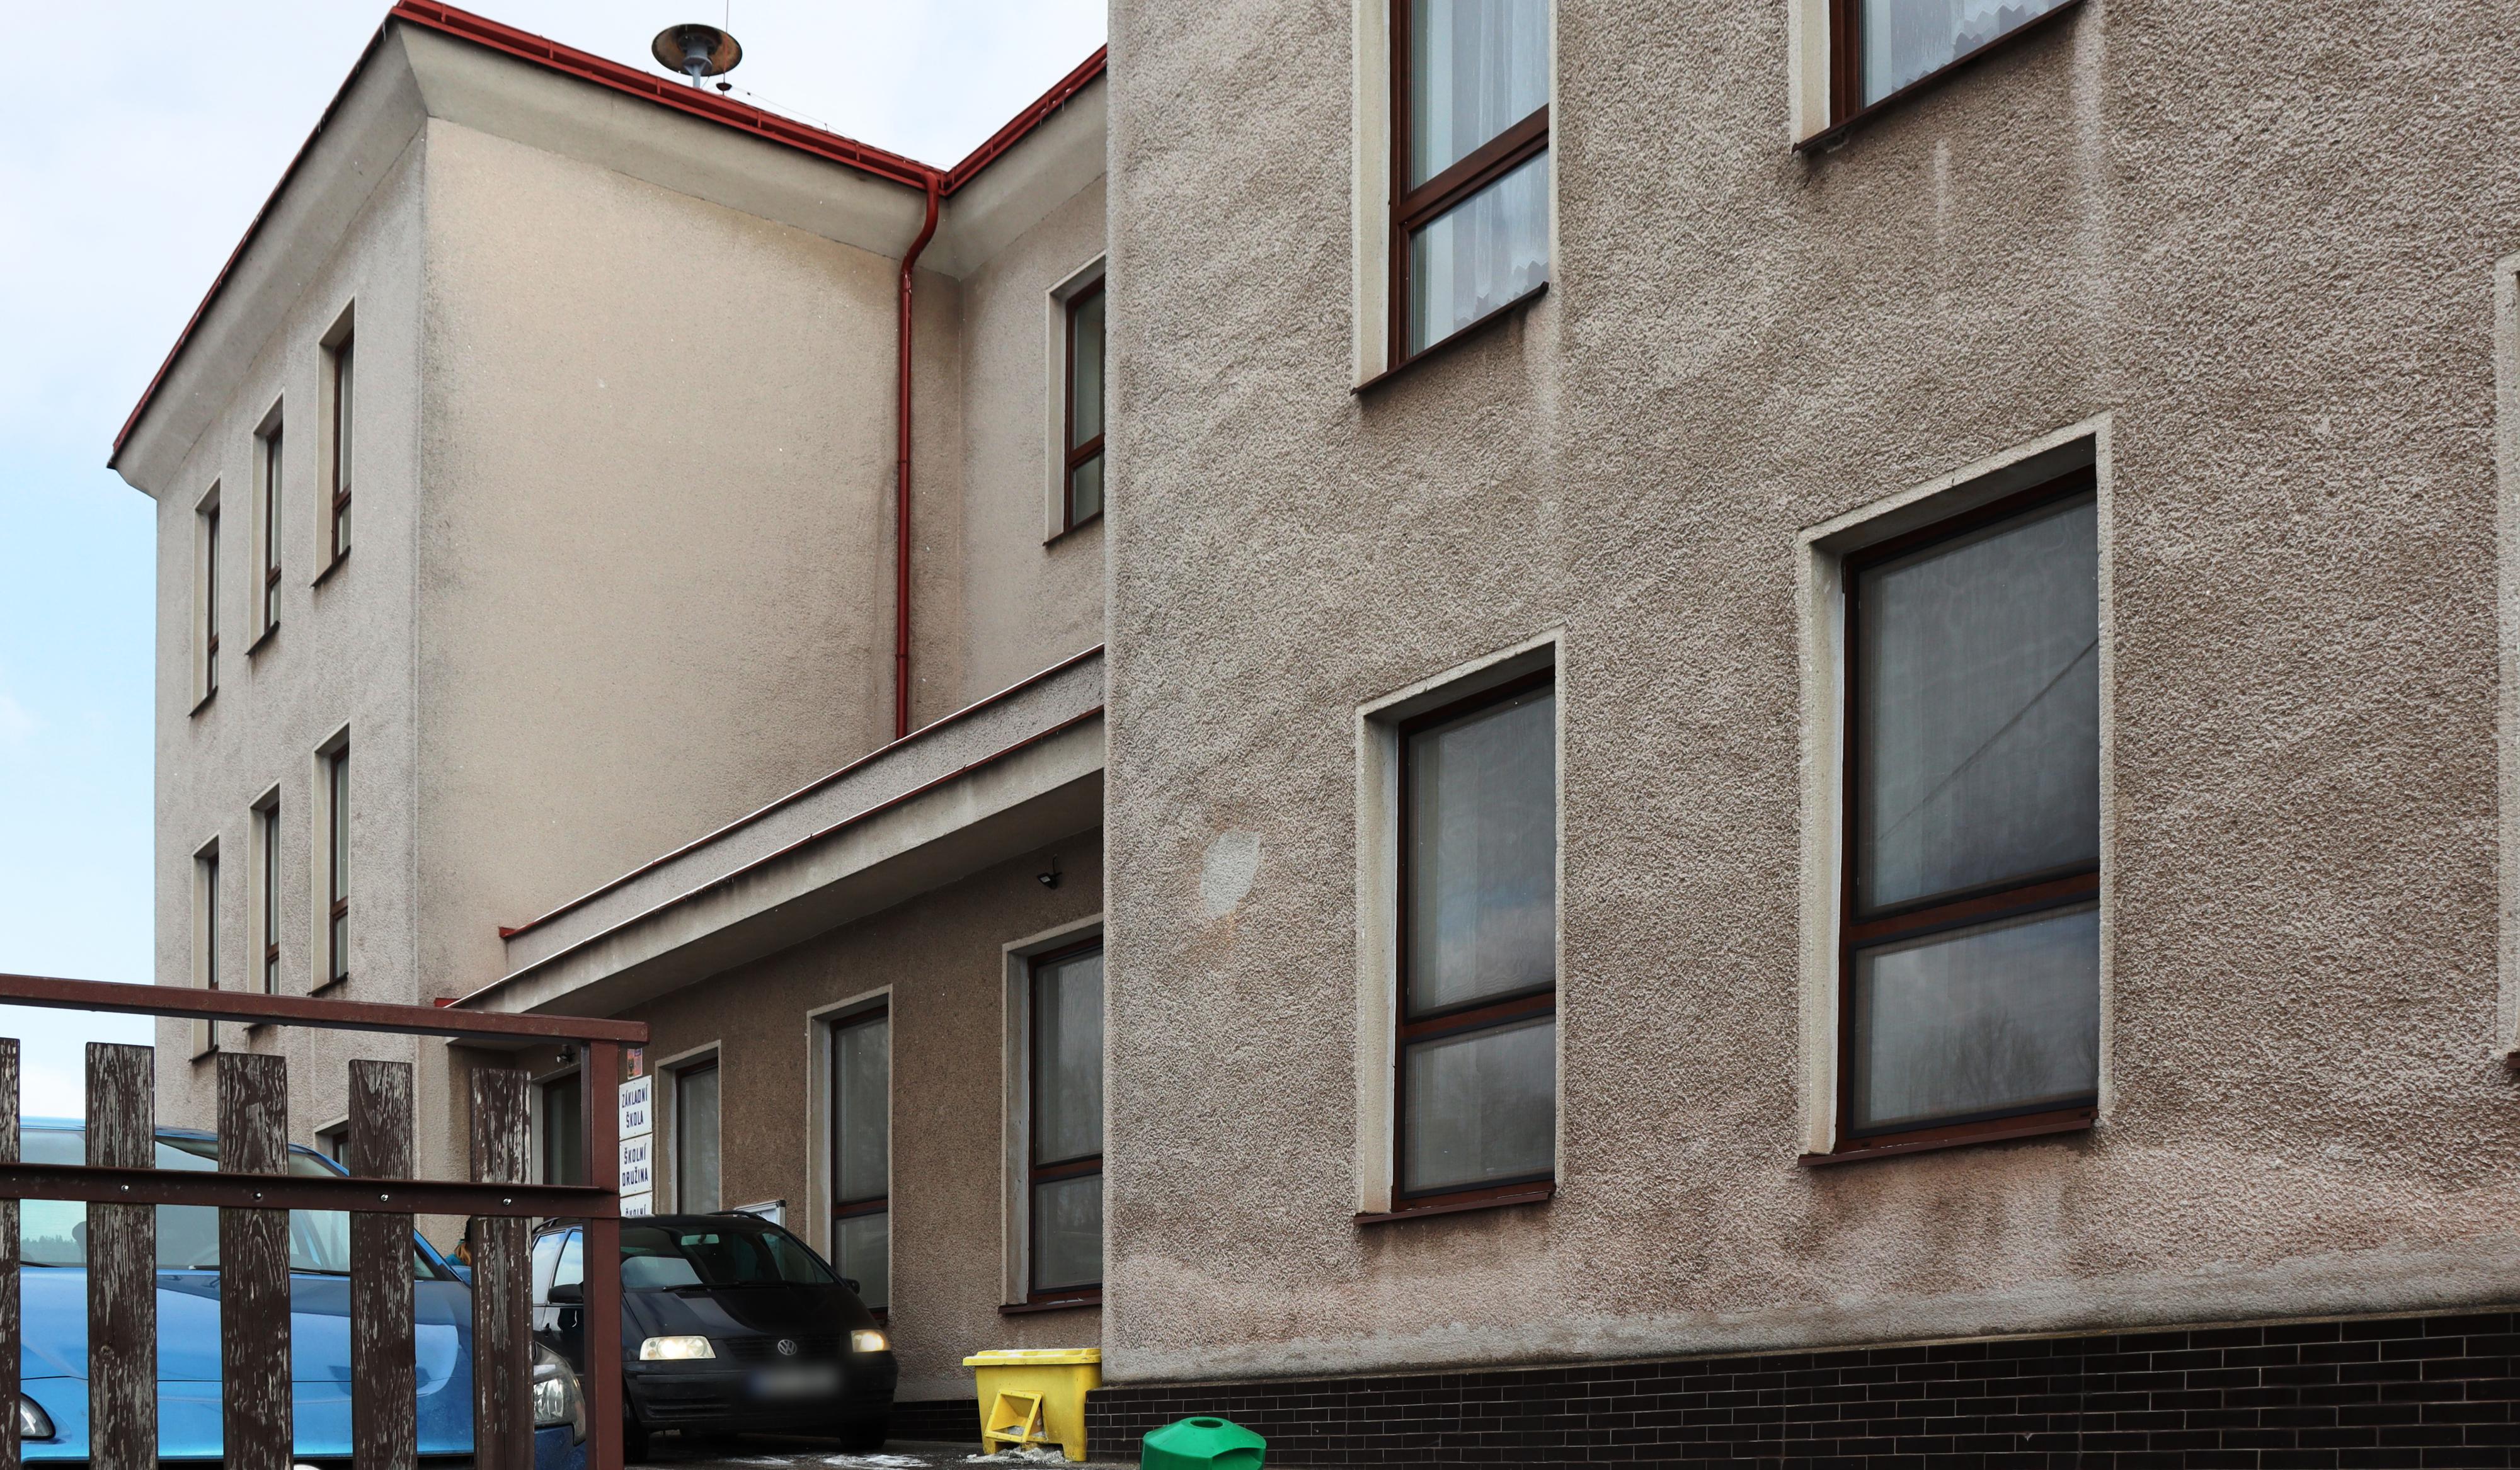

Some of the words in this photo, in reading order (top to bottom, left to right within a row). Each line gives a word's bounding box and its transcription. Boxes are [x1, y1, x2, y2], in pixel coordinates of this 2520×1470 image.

[622, 1084, 648, 1108] ZÁKLADNÍ
[626, 1110, 644, 1128] ŠKOLA
[624, 1142, 646, 1165] ŠKOLNÍ
[622, 1166, 648, 1187] DRUŽINA
